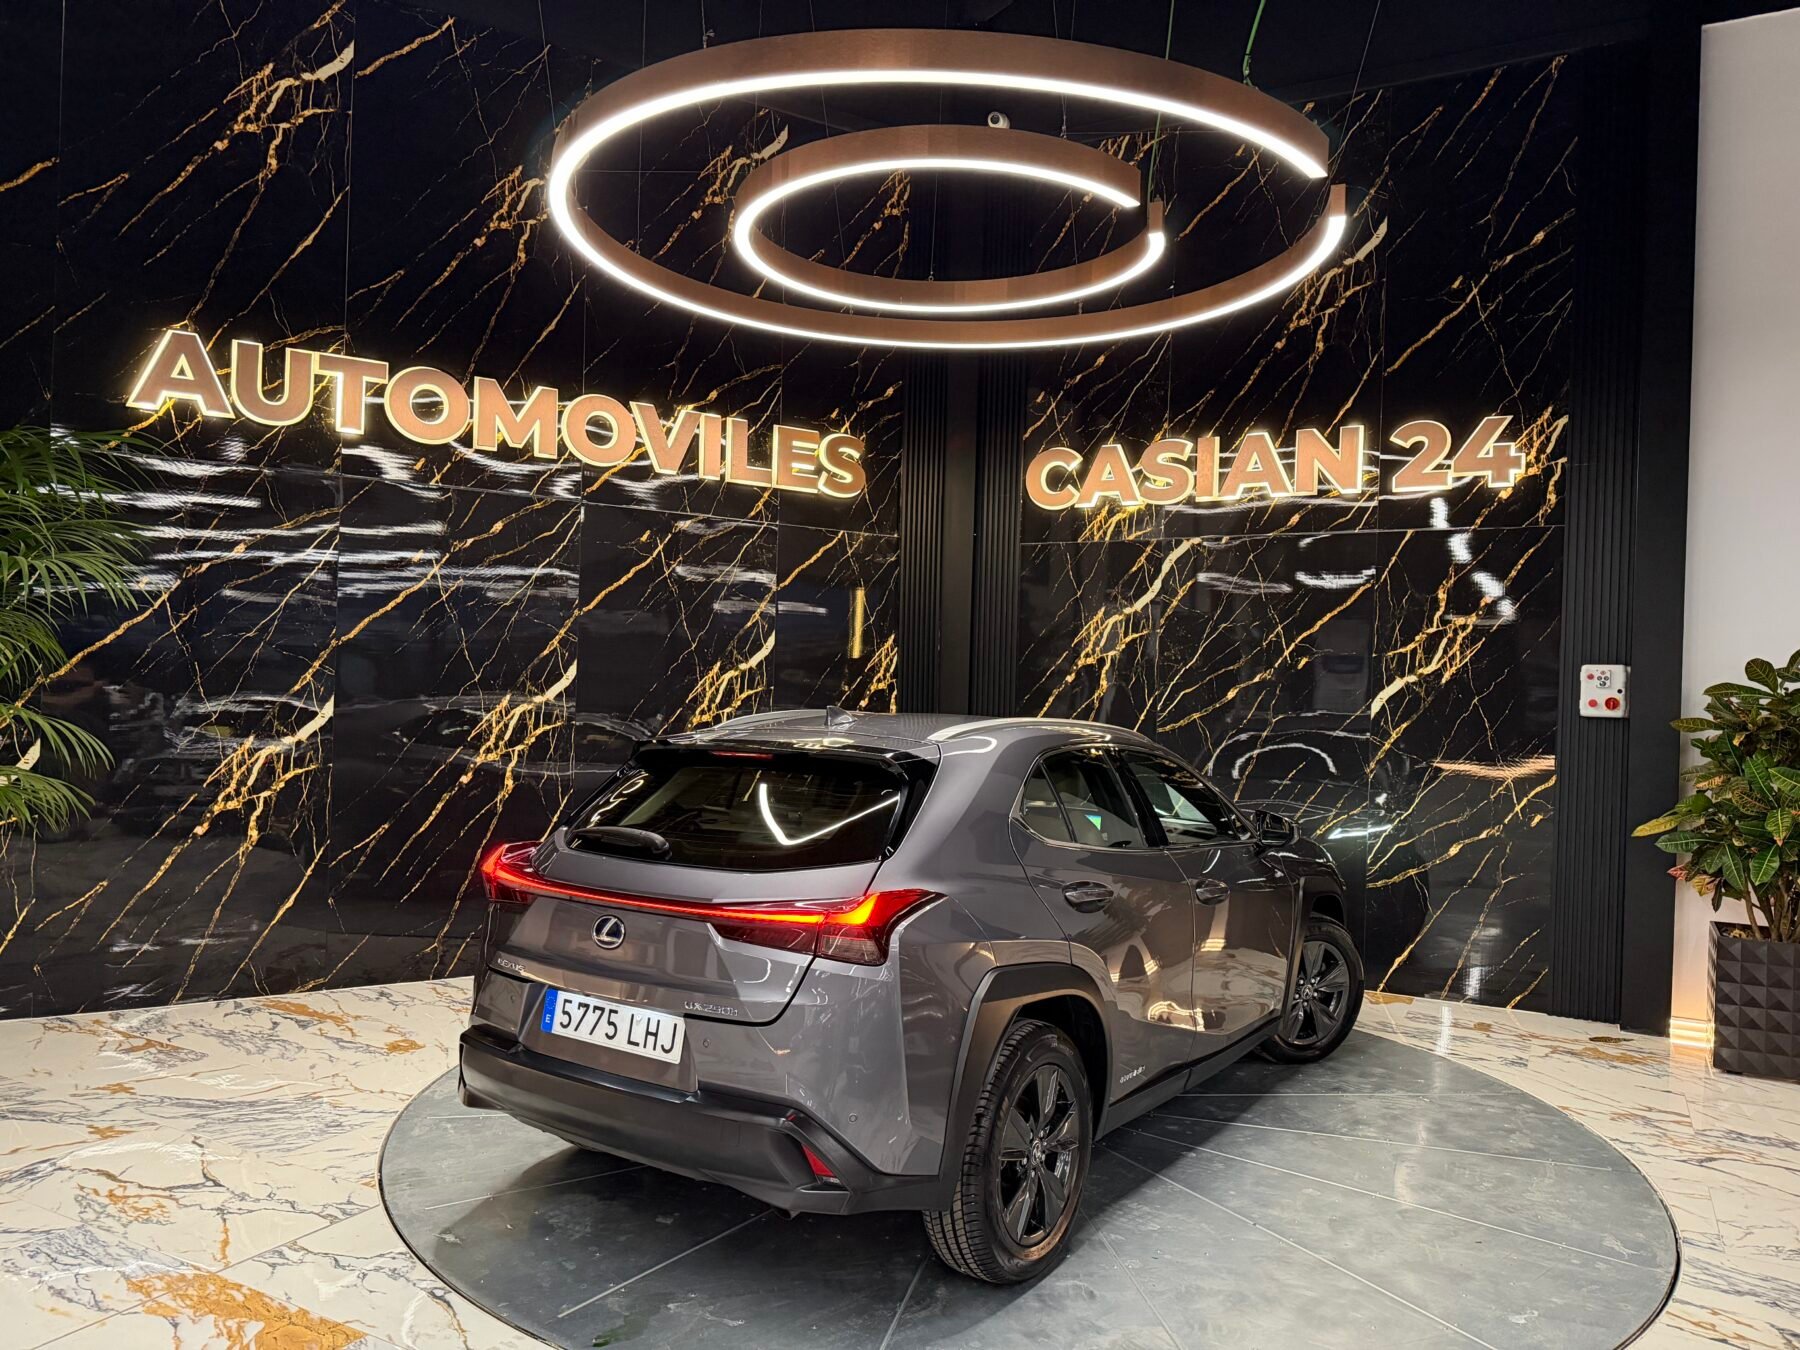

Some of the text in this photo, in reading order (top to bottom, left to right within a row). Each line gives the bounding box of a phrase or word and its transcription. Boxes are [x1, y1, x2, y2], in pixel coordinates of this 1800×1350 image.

[128, 329, 1526, 511] AUTOMOVILES CASIAN 24
[559, 998, 678, 1055] 5775 LHJ
